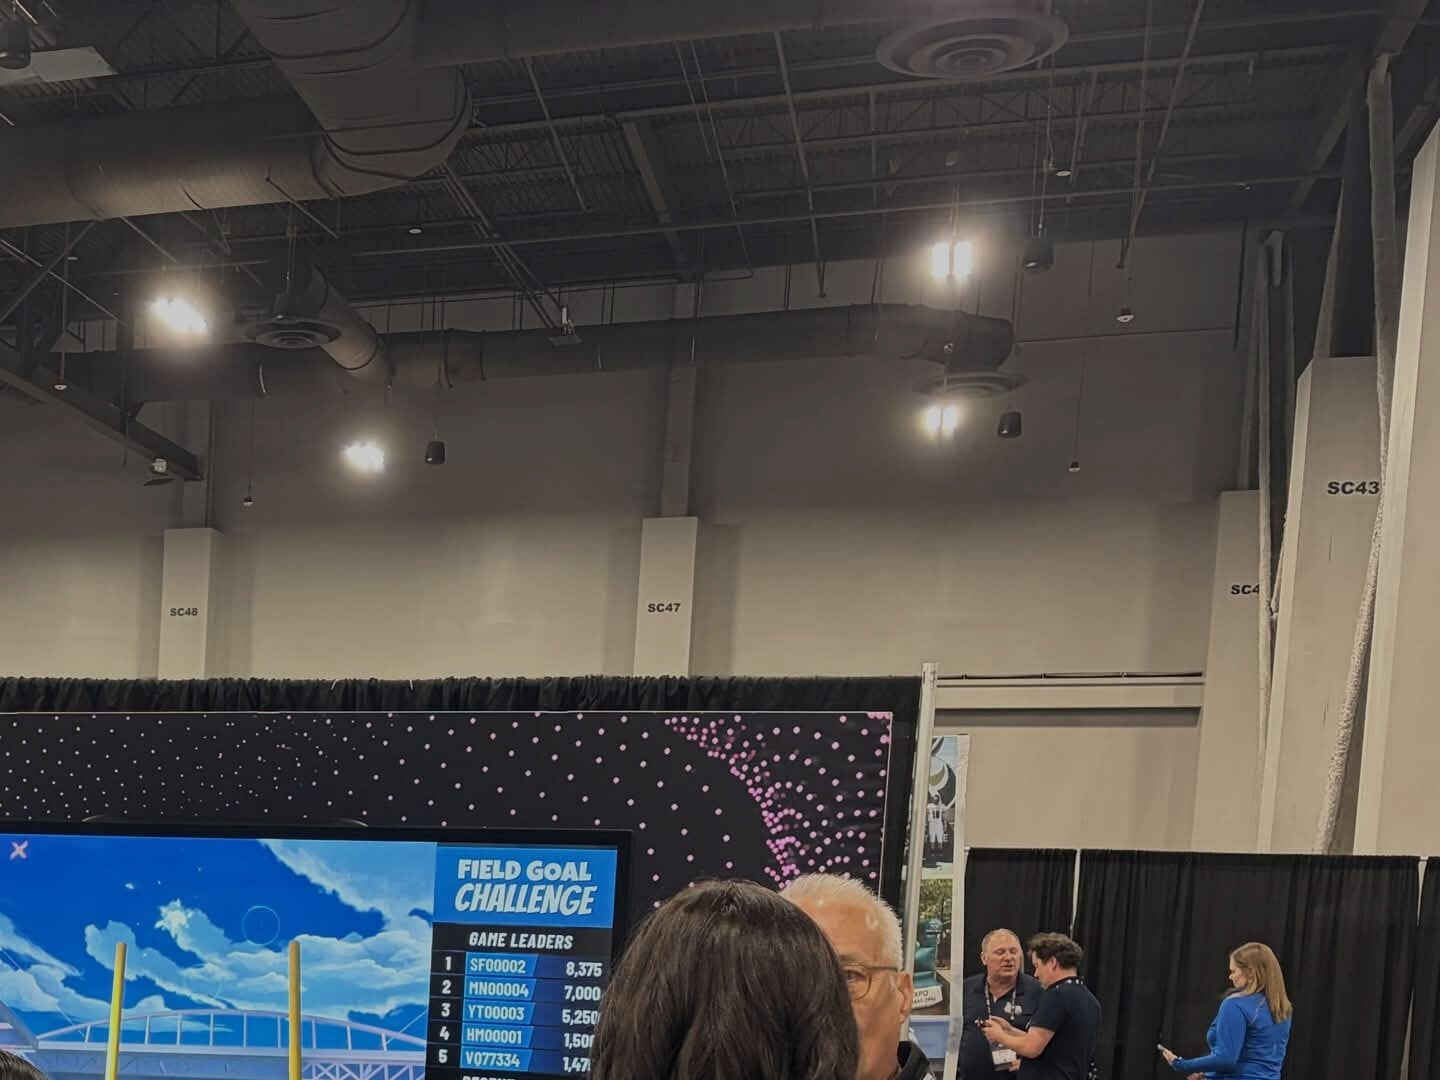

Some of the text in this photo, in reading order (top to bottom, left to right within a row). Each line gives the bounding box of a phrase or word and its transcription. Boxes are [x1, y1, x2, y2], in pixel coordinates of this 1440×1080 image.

[1327, 481, 1380, 495] SC43
[169, 607, 198, 617] SC48
[647, 603, 681, 613] SC47
[457, 859, 592, 882] FIELD GOAL
[455, 882, 598, 916] CHALLENGE
[468, 931, 574, 950] GAME LEADERS
[444, 956, 603, 978] 1 SF00002 8,375
[441, 979, 452, 995] 2
[564, 985, 601, 1002] 7,000
[441, 1003, 451, 1018] 3
[468, 1005, 525, 1021] YT00003
[439, 1026, 450, 1041] 4
[466, 1028, 522, 1044] HM00001
[438, 1049, 591, 1073] 5 VQ77334 1,47
